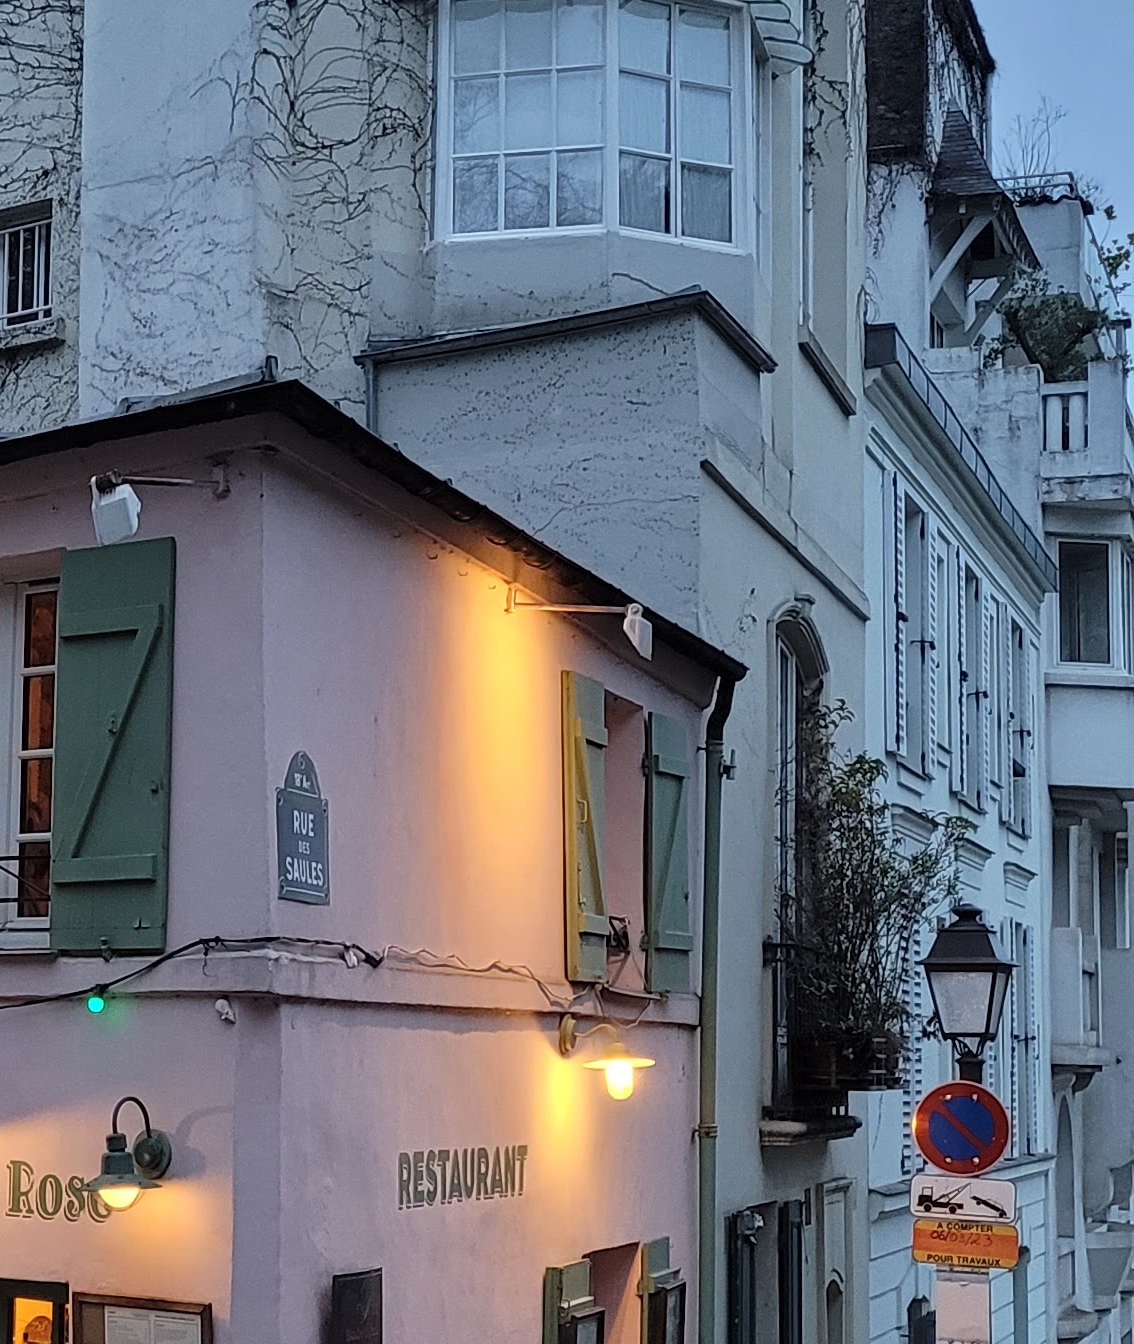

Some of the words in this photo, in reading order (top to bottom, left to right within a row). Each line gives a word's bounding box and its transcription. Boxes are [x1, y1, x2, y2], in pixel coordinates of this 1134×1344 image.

[293, 809, 315, 837] RUE
[298, 840, 311, 855] DES
[285, 856, 324, 887] SAULES
[397, 1144, 528, 1211] RESTAURANT
[946, 1222, 994, 1233] COMPTER
[926, 1253, 954, 1263] POUR
[956, 1255, 1001, 1267] TRAVAUX
